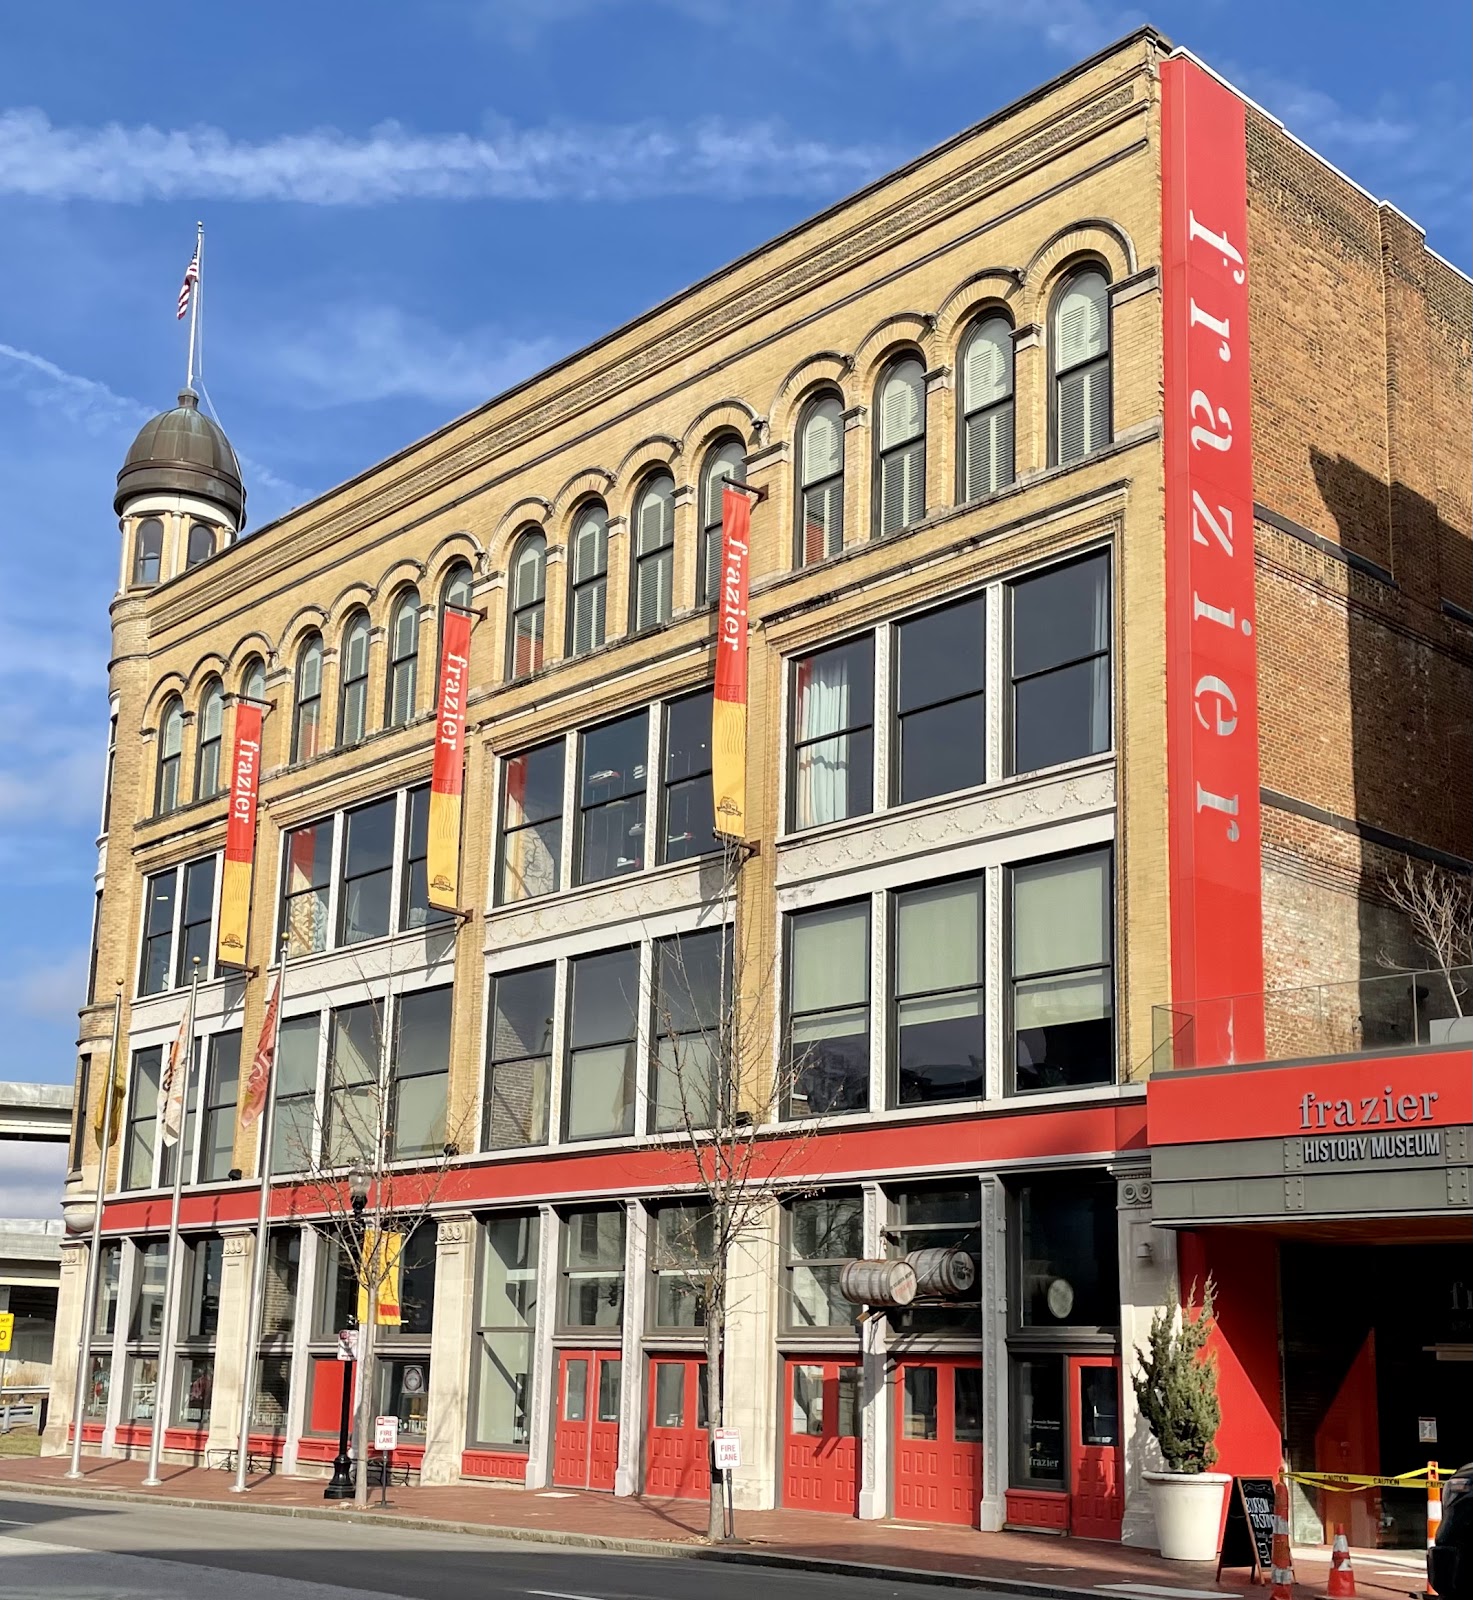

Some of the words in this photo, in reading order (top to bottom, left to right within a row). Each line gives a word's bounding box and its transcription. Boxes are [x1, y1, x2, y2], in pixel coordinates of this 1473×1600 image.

[1189, 209, 1252, 843] frazier
[723, 536, 748, 652] frazier
[441, 651, 468, 751] frazier
[234, 738, 259, 824] frazier
[1299, 1085, 1439, 1129] frazier
[1303, 1137, 1368, 1163] HISTORY
[1371, 1132, 1440, 1159] MUSEUM
[719, 1453, 738, 1461] LANE
[720, 1444, 736, 1452] FIRE
[1028, 1456, 1059, 1468] frazier
[1323, 1474, 1349, 1482] CAUTION
[1373, 1477, 1400, 1486] CAUTION
